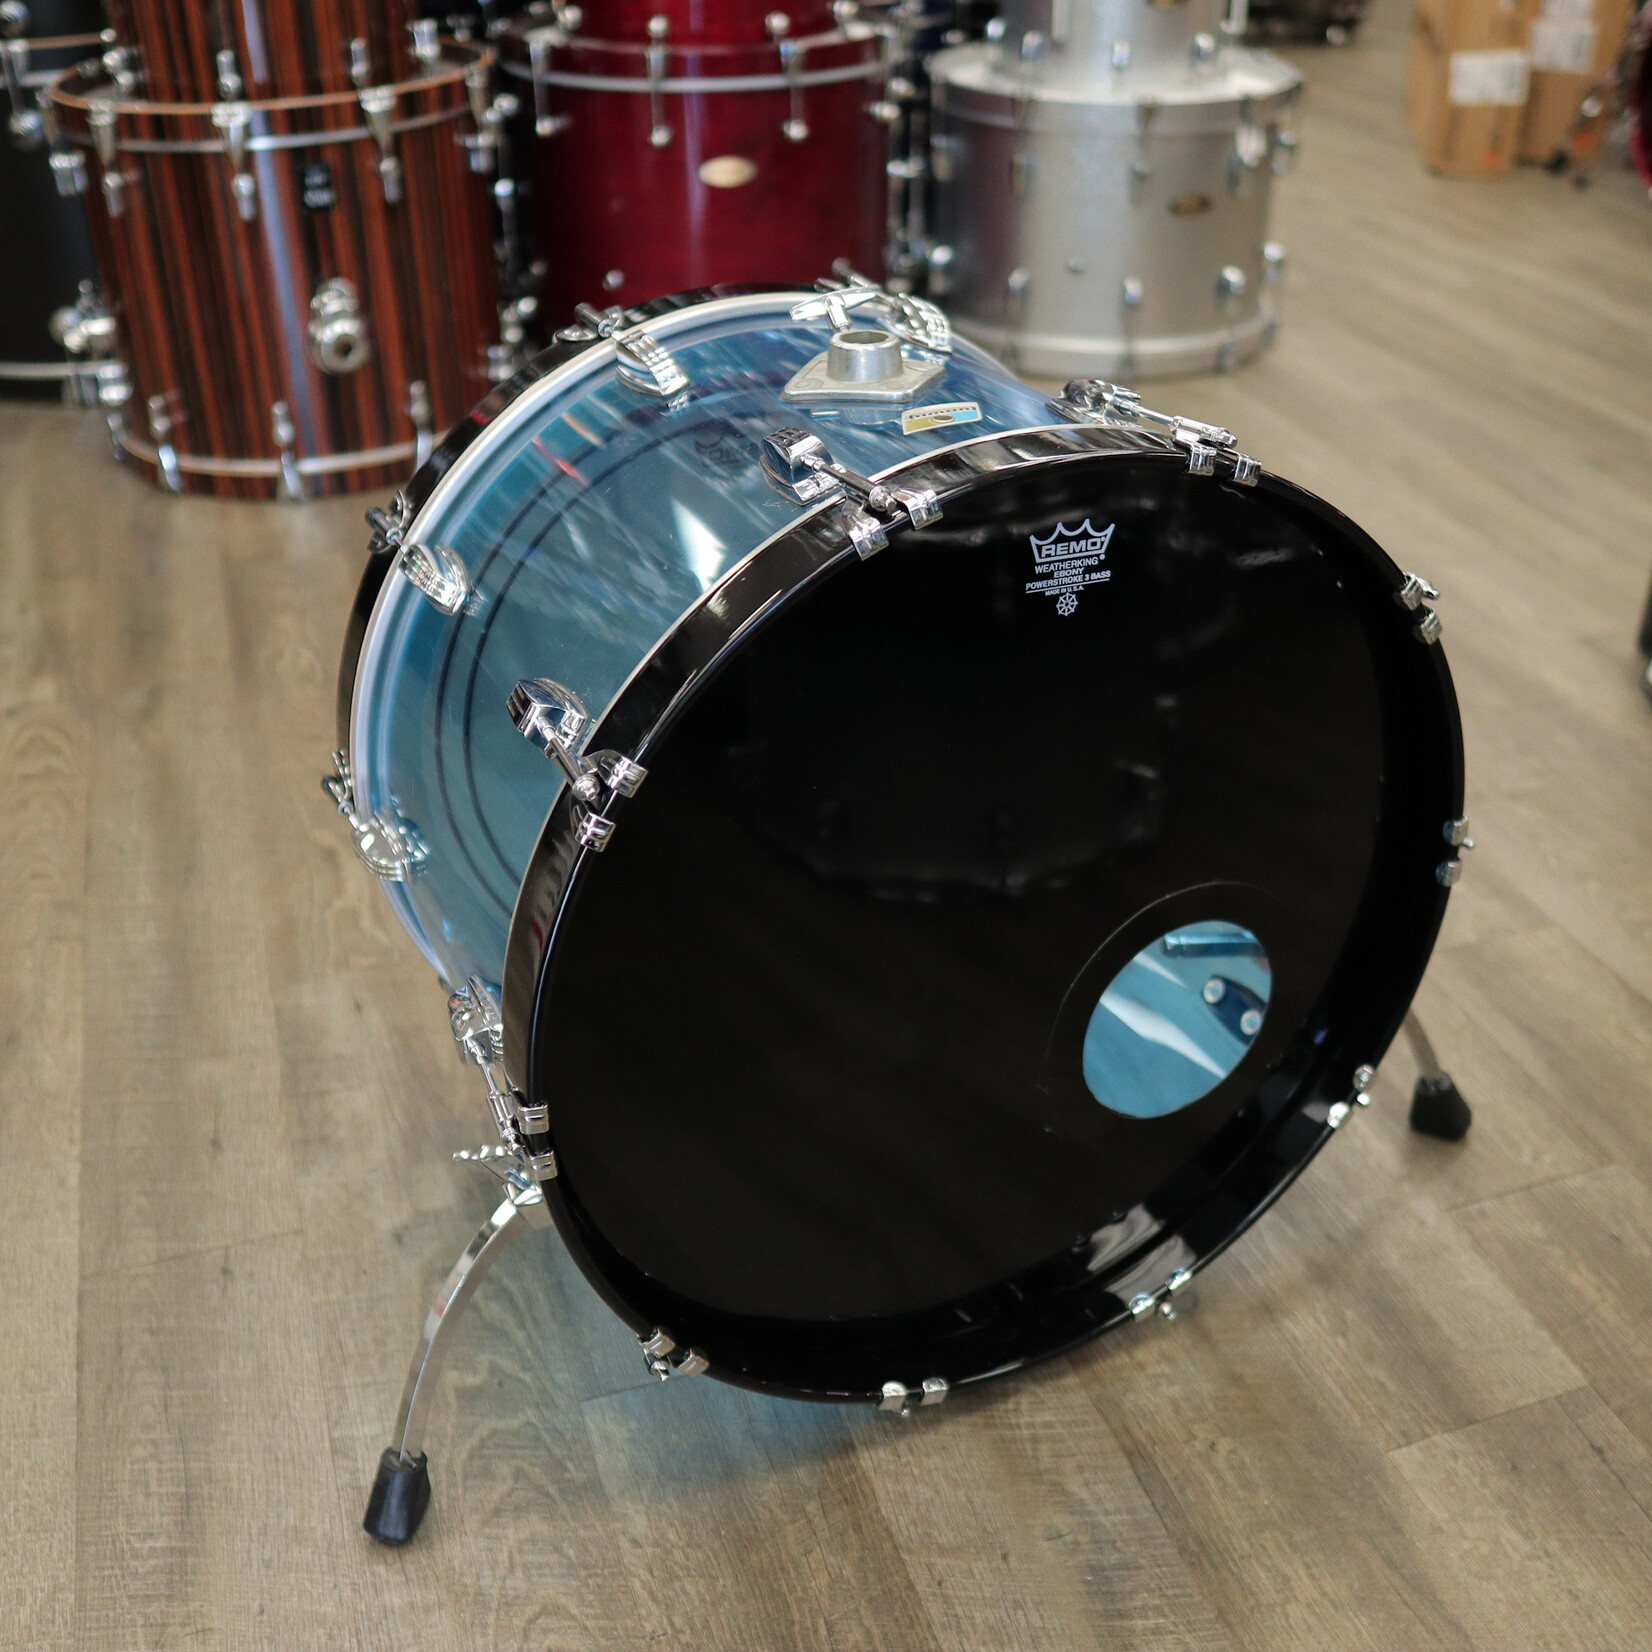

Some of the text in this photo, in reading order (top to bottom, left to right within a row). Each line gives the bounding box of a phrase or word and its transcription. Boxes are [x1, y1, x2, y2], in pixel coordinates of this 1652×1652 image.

[1041, 538, 1101, 558] REMO
[1035, 557, 1099, 574] WEATHERKING
[1053, 567, 1085, 579] EBONY
[1025, 575, 1083, 590] POWERSTROKE
[1090, 570, 1111, 580] BASS
[1045, 588, 1060, 596] MADE
